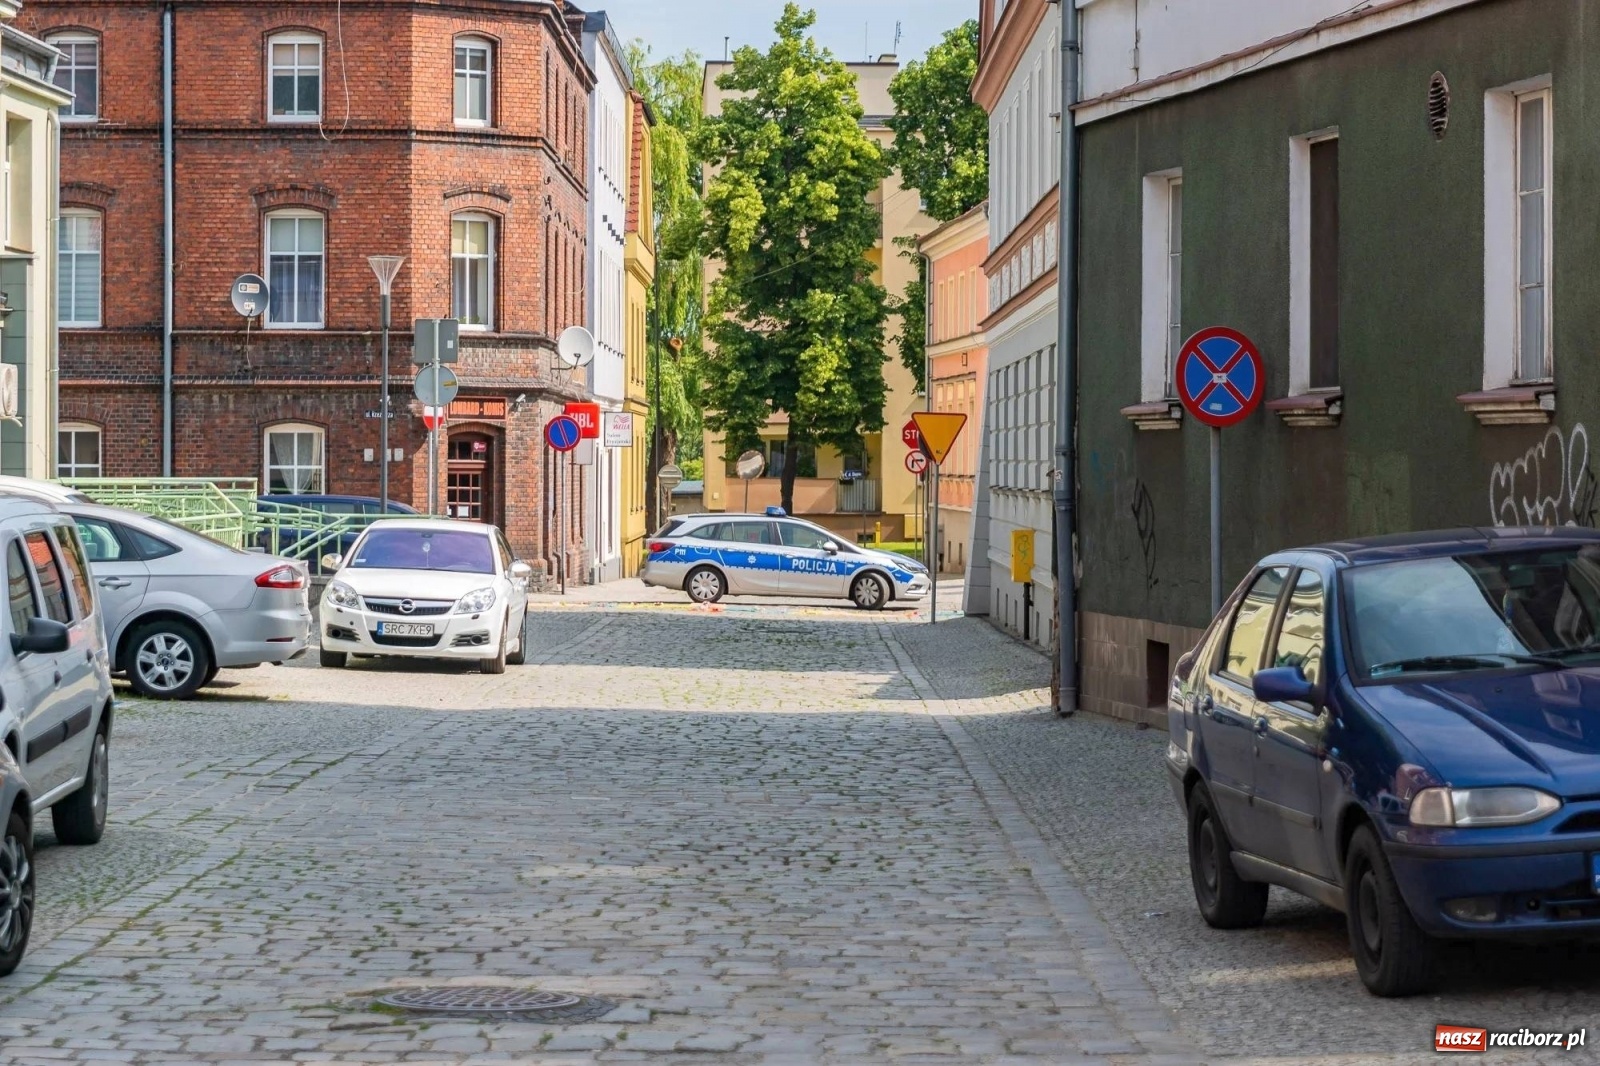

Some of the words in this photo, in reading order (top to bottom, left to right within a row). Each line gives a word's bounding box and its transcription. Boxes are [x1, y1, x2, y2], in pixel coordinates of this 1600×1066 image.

[904, 429, 920, 440] ST
[792, 558, 837, 573] POLICJA
[384, 623, 405, 635] SRC
[407, 624, 432, 636] 7KE9
